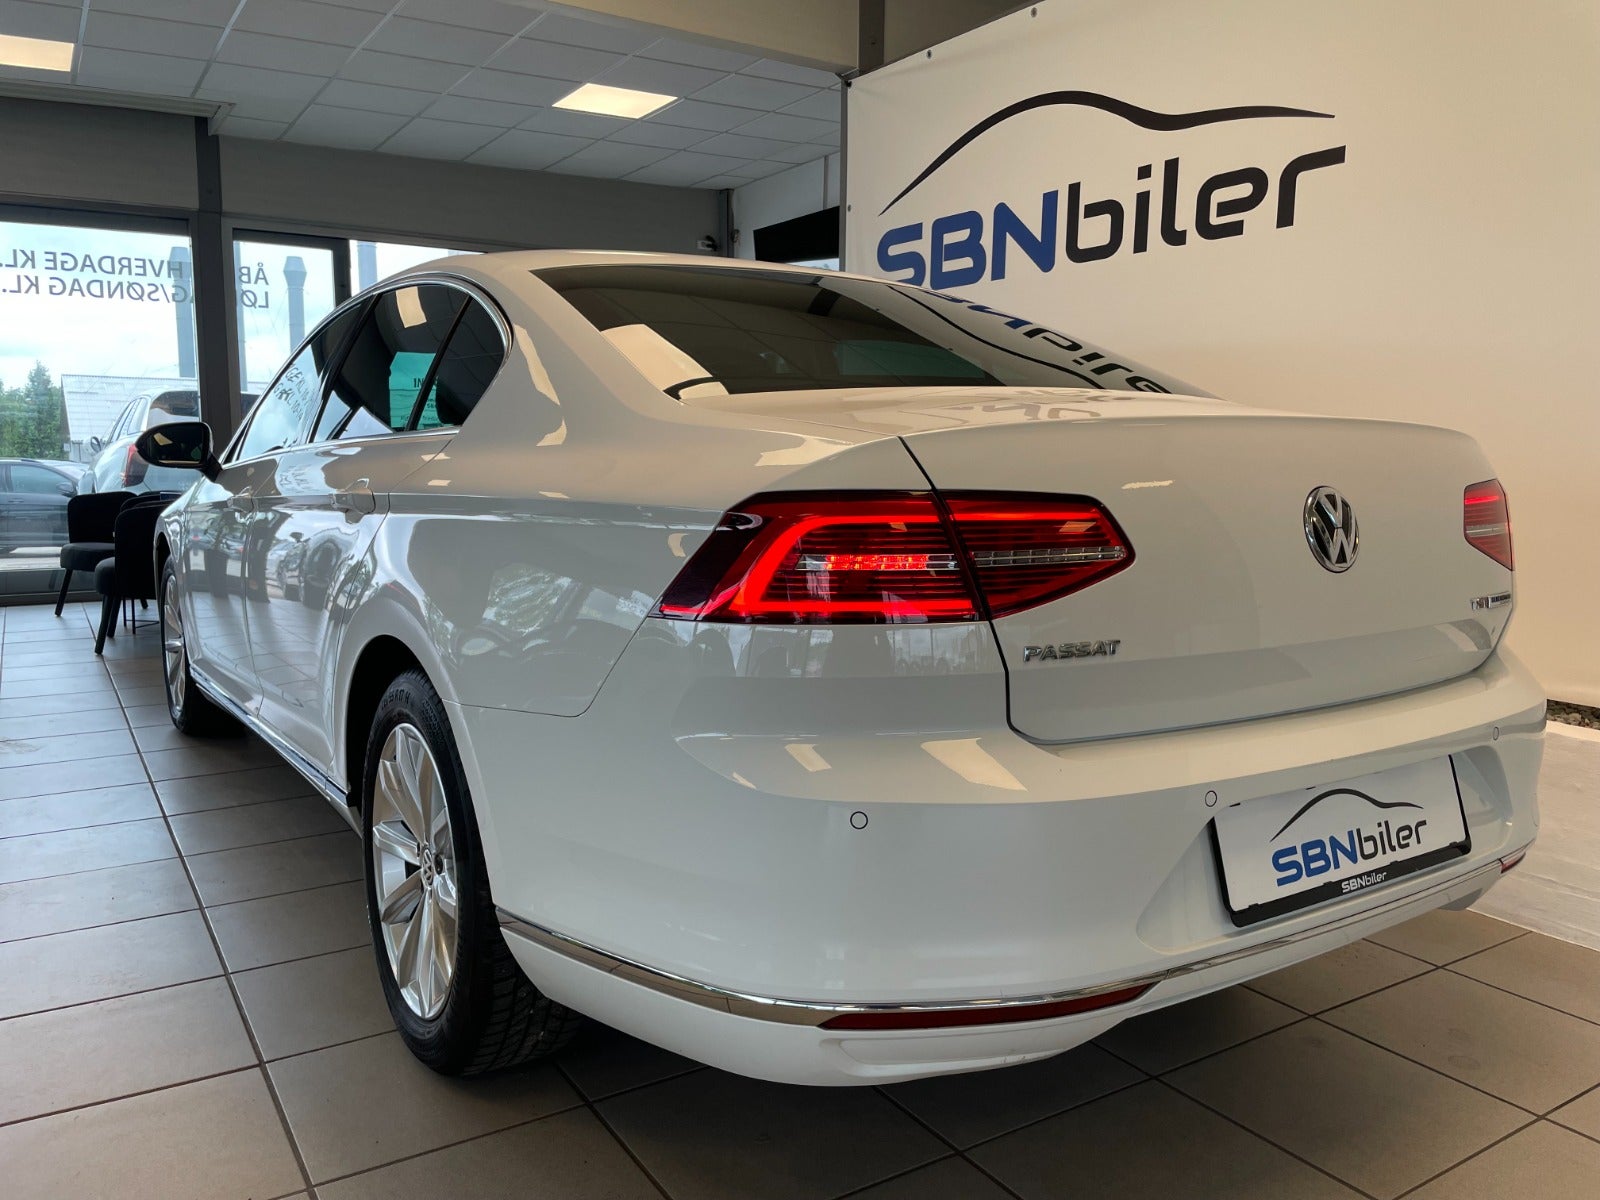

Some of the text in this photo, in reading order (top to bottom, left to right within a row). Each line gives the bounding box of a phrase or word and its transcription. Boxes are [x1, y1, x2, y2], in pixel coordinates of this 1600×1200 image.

[877, 145, 1346, 290] SBNbiler
[1023, 640, 1121, 662] PASSAT
[1272, 819, 1427, 887] SBNbiler
[1341, 871, 1387, 893] SBNbiler
